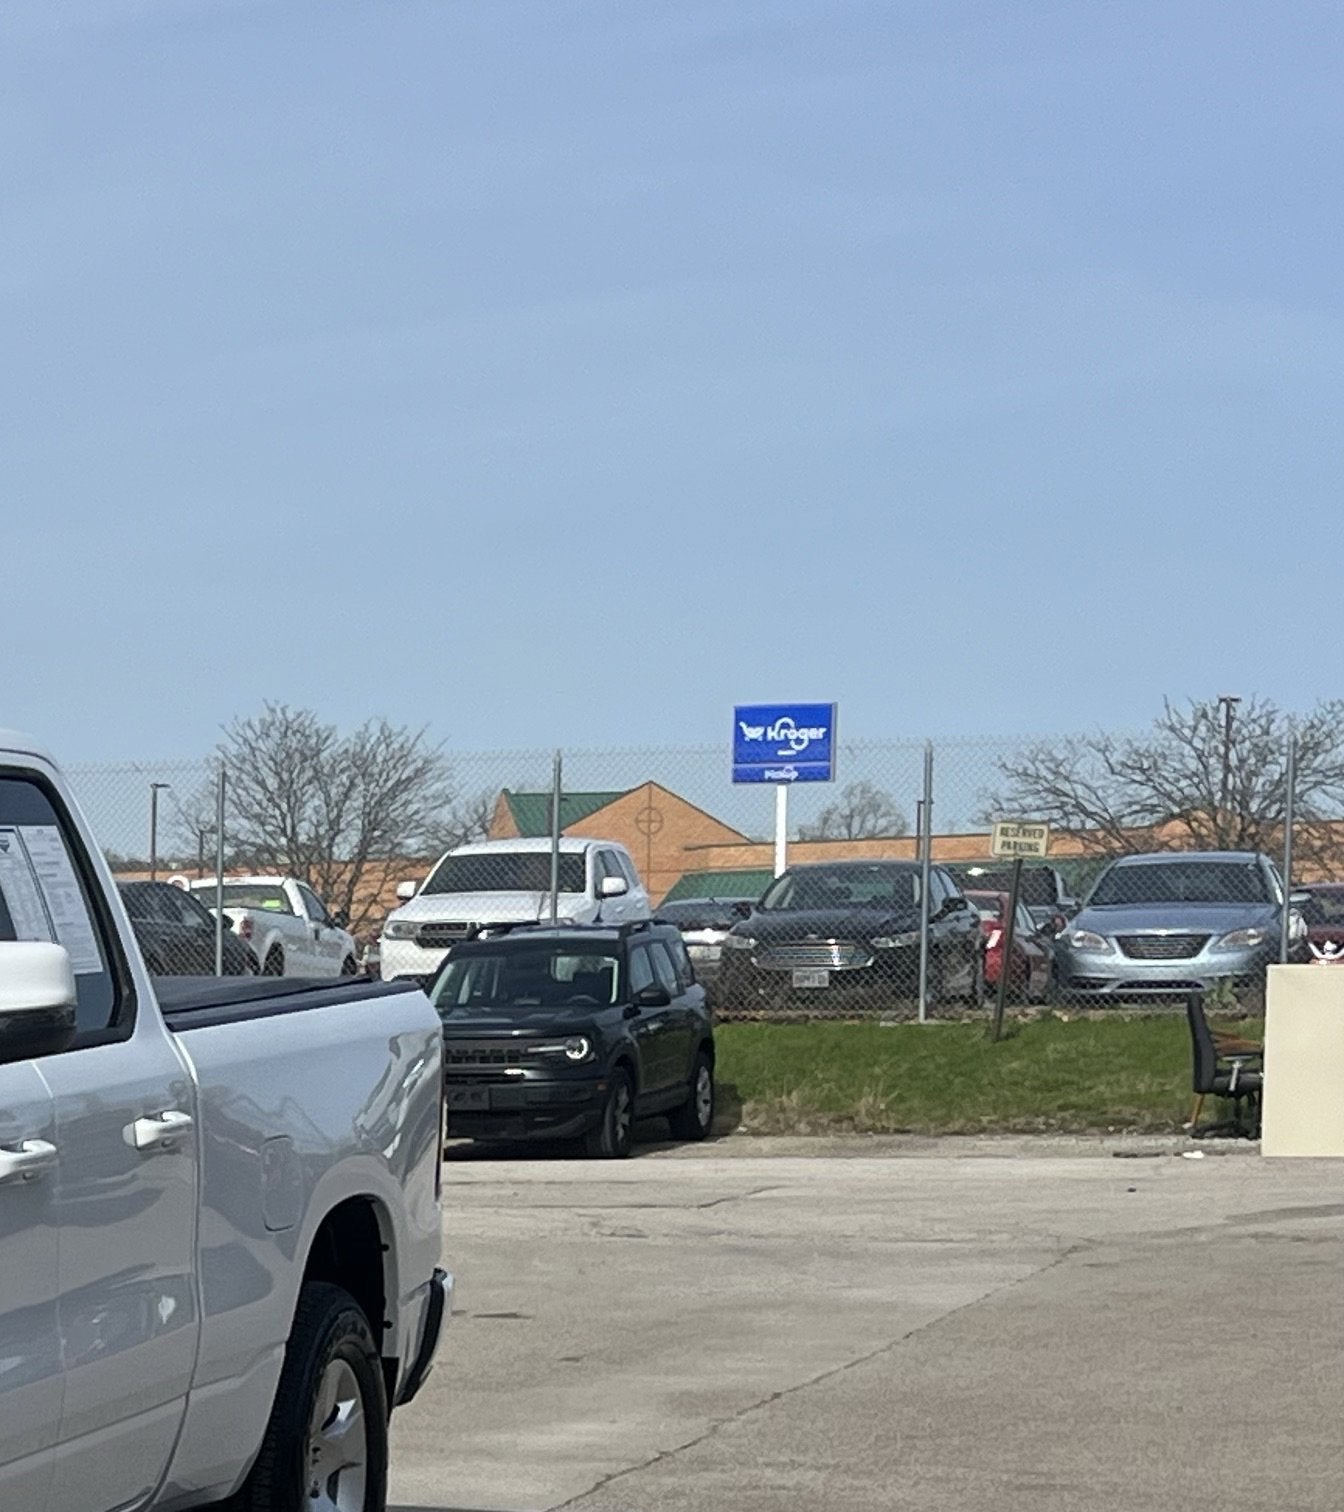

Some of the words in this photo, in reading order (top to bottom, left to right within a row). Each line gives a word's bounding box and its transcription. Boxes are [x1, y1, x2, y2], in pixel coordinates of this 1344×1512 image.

[767, 717, 827, 750] Kroger
[1000, 826, 1045, 839] RESERVED
[1000, 840, 1041, 853] PARKING
